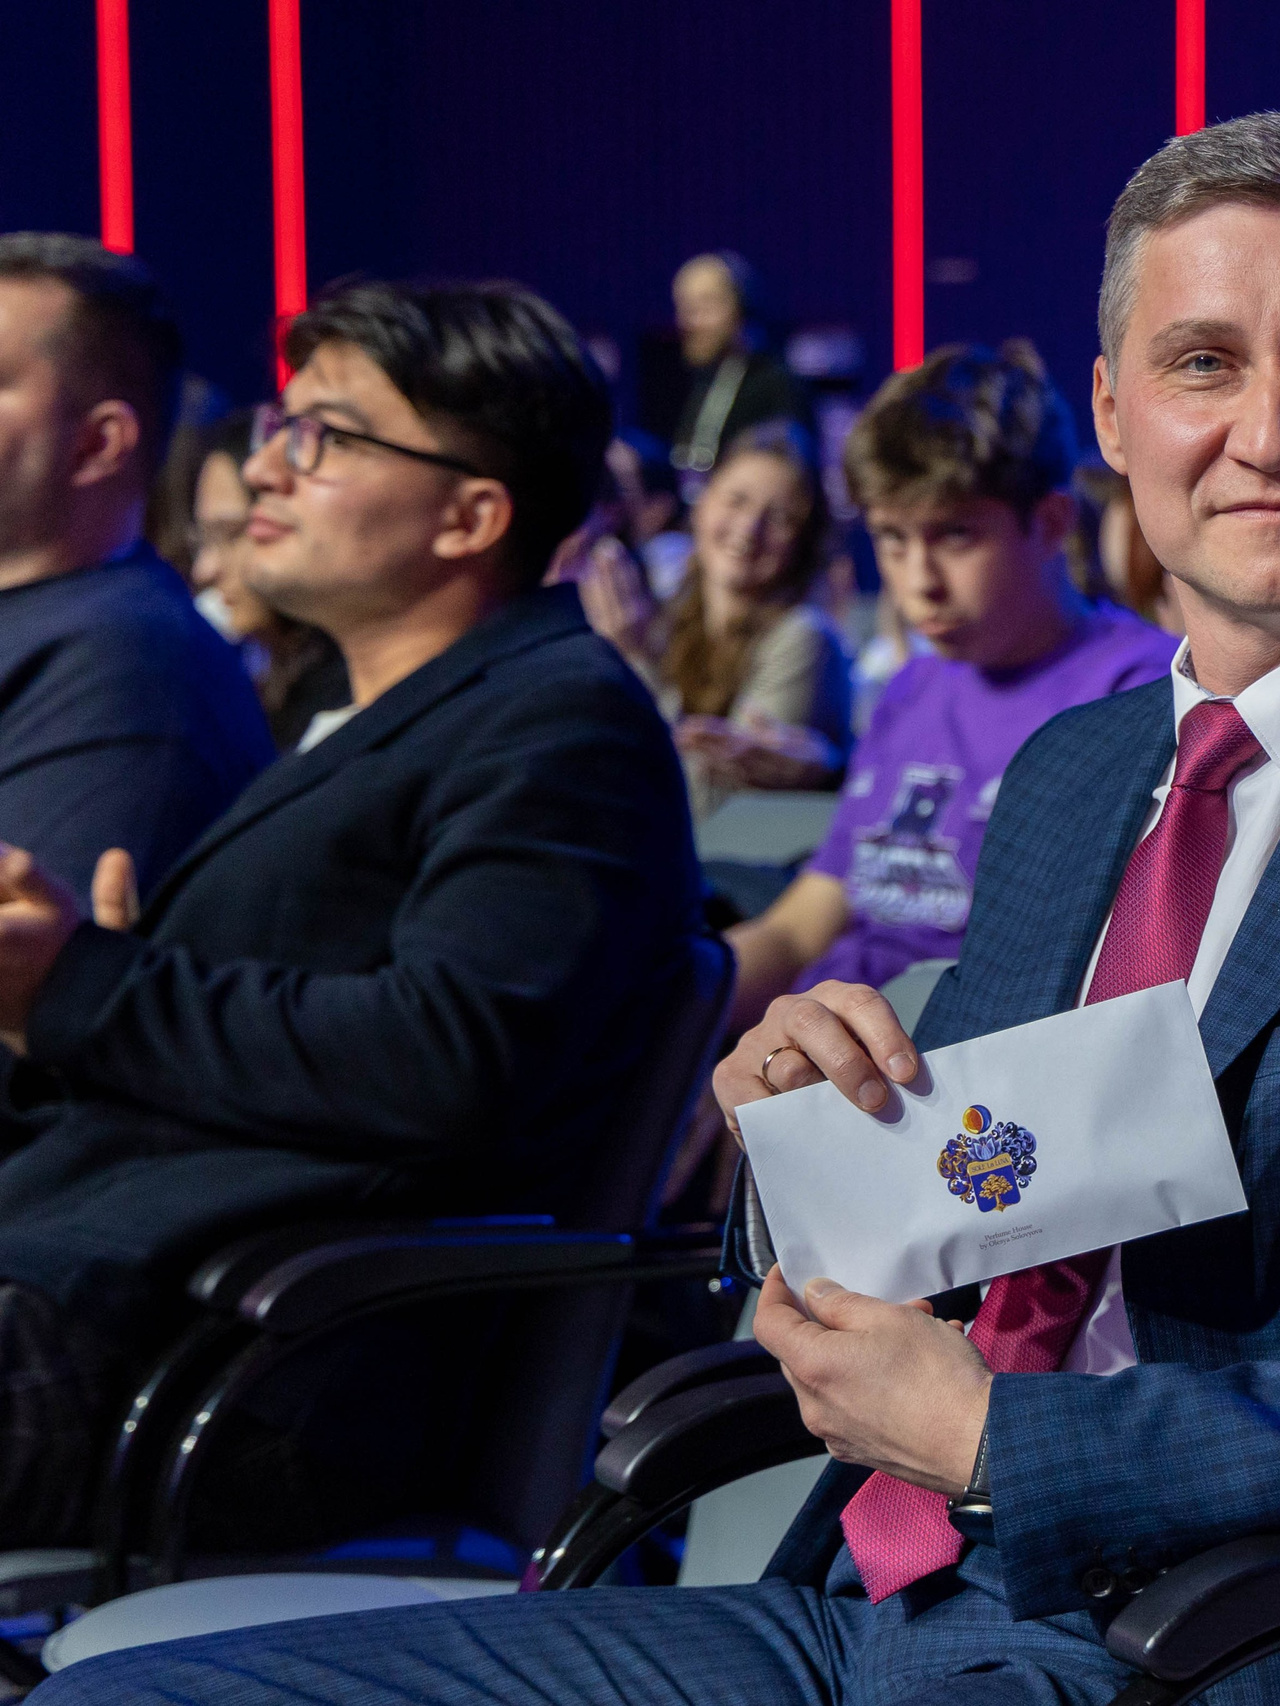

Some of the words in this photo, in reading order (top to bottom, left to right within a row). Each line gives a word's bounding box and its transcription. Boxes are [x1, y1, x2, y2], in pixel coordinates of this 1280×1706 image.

[979, 1243, 988, 1251] by
[988, 1237, 1010, 1247] Olesya
[1010, 1228, 1043, 1240] Solovyova
[984, 1230, 1011, 1241] Perfume
[1012, 1224, 1033, 1234] House
